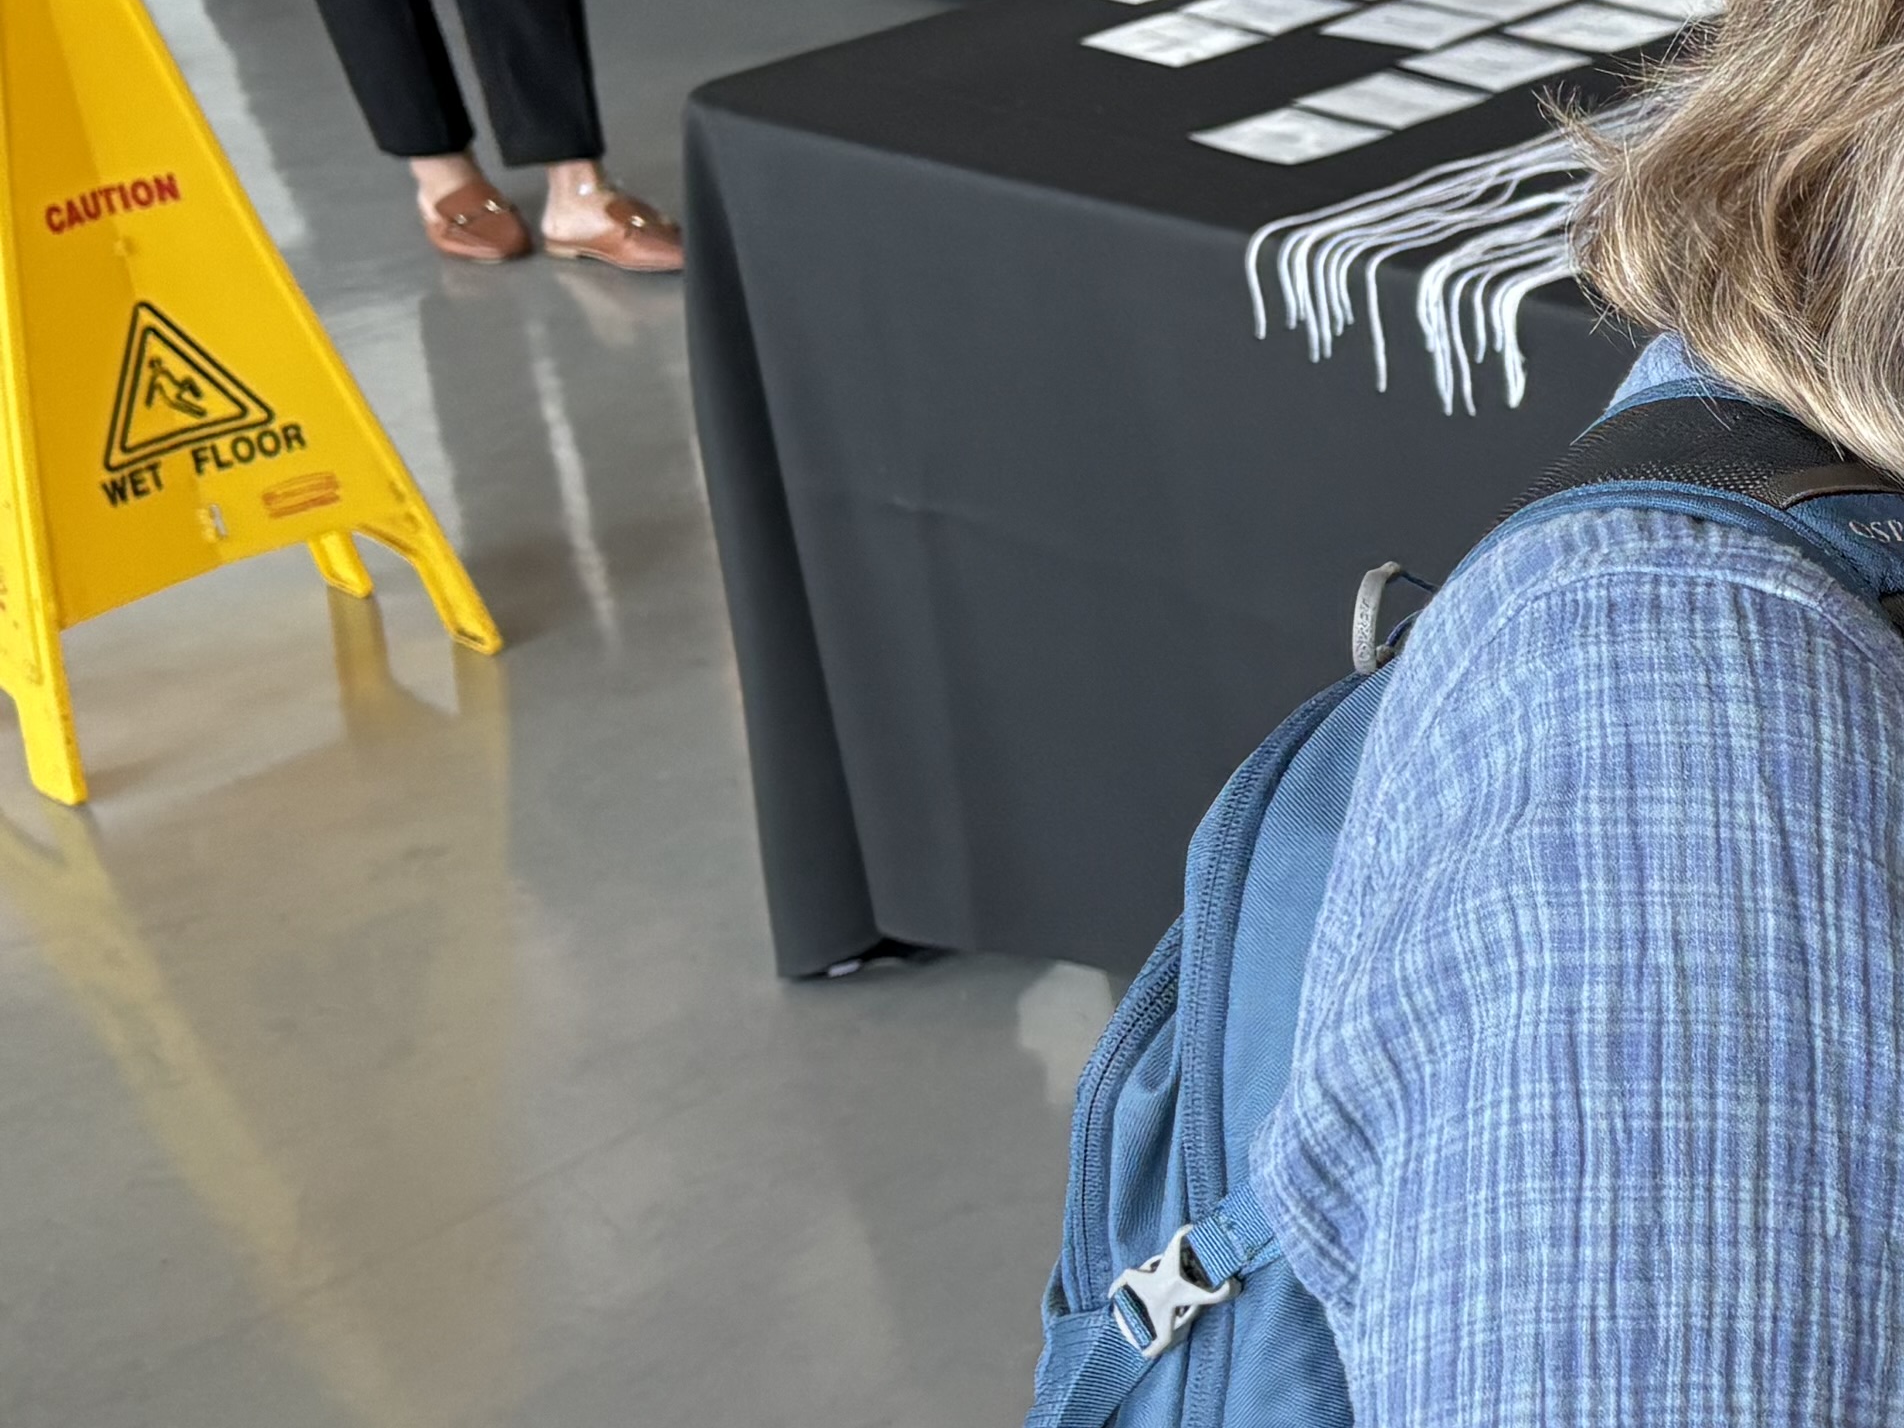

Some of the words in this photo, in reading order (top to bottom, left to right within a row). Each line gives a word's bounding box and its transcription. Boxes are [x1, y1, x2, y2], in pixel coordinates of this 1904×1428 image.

[45, 173, 182, 234] CAUTION
[101, 464, 164, 507] WET
[191, 423, 307, 475] FLOOR
